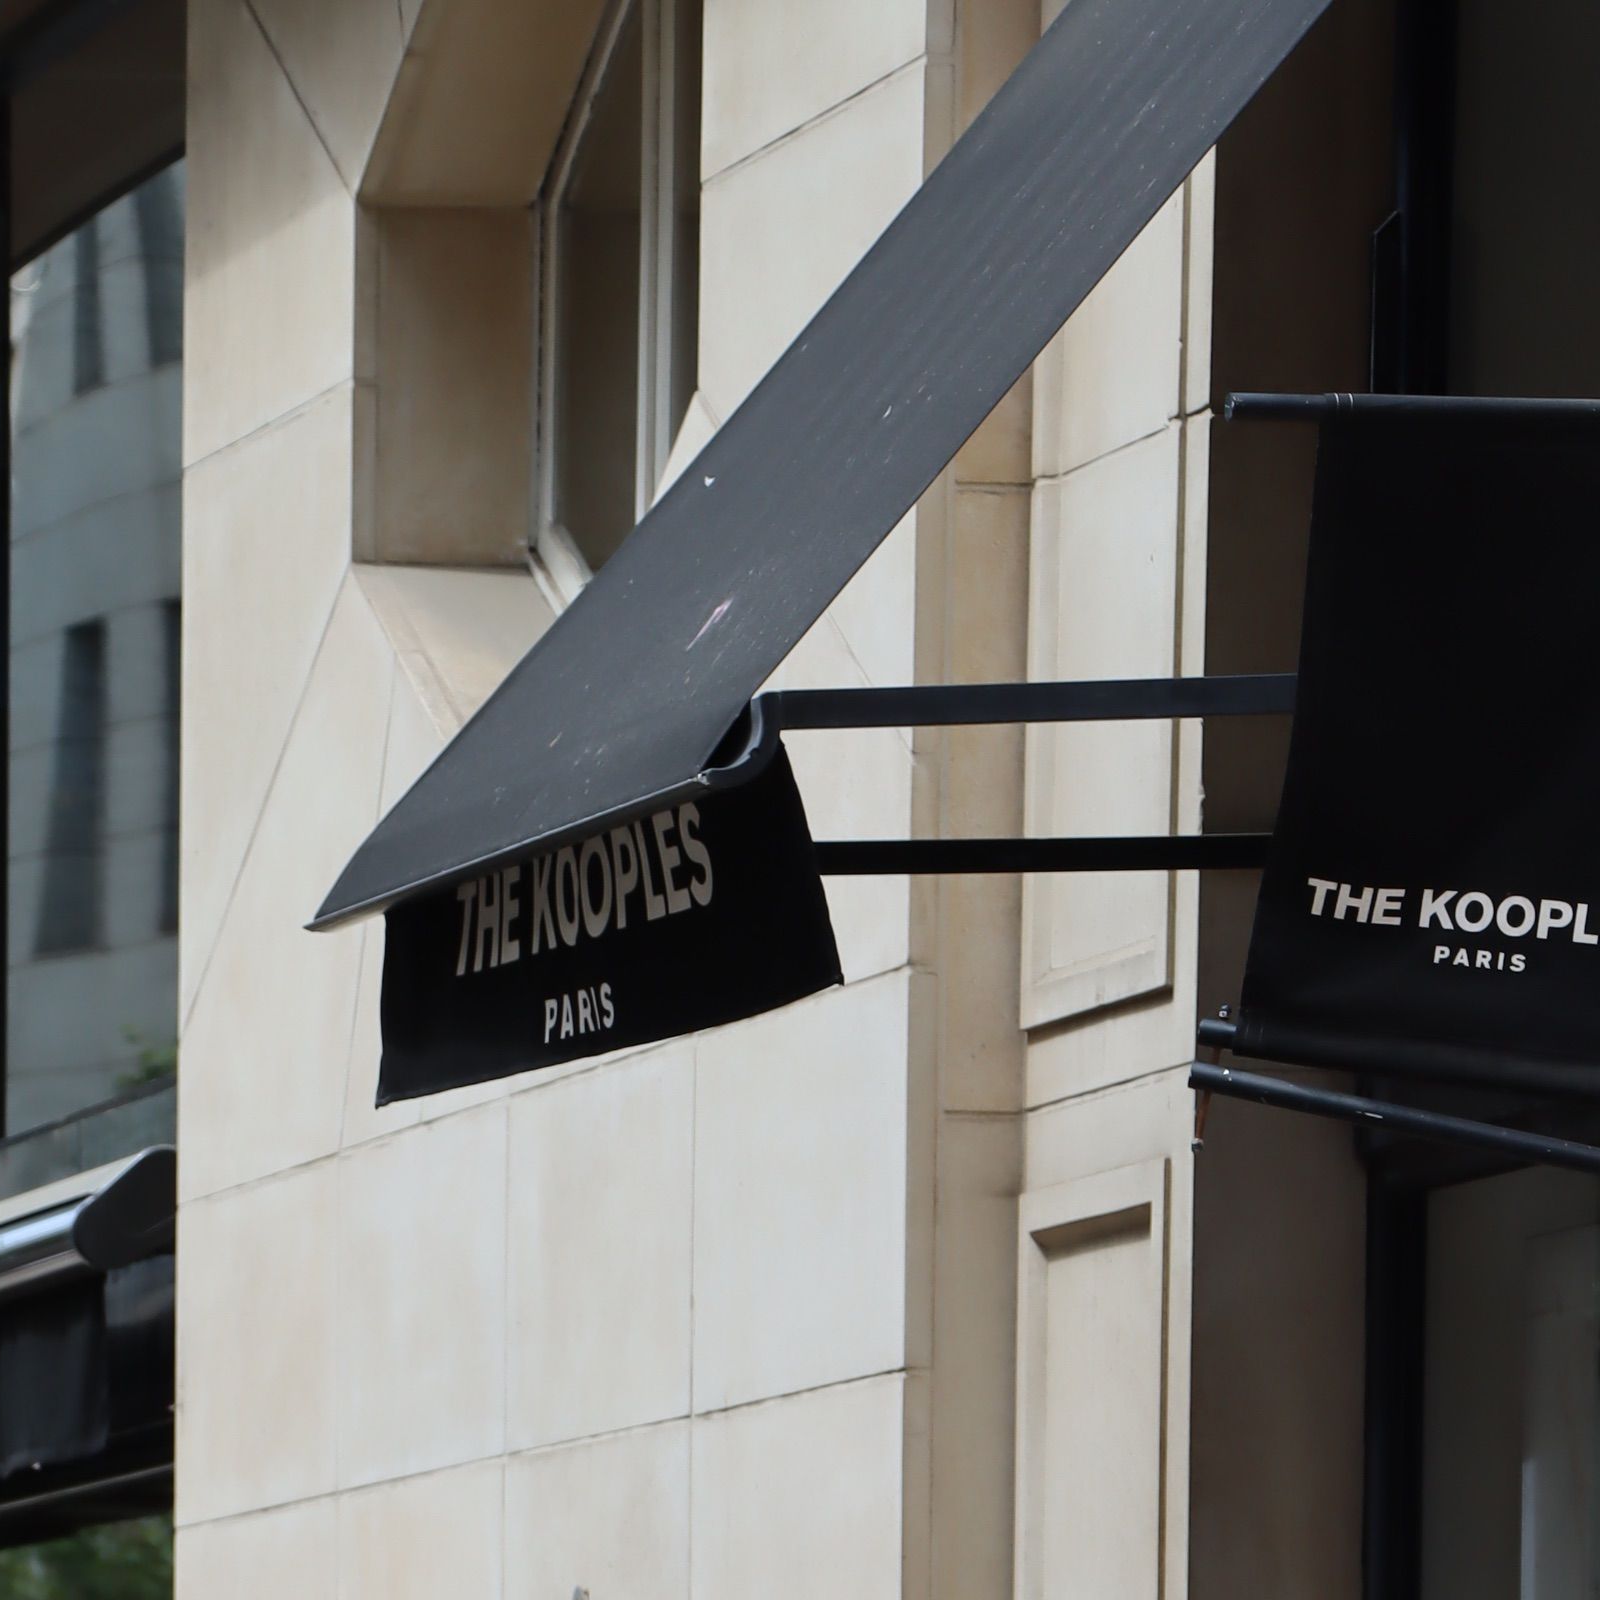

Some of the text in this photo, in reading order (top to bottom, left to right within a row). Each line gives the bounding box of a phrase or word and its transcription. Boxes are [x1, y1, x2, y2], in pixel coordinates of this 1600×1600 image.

[456, 801, 713, 976] THE KOOPLES
[1308, 877, 1406, 926] THE
[1433, 945, 1527, 973] PARIS
[544, 982, 615, 1044] PARIS
